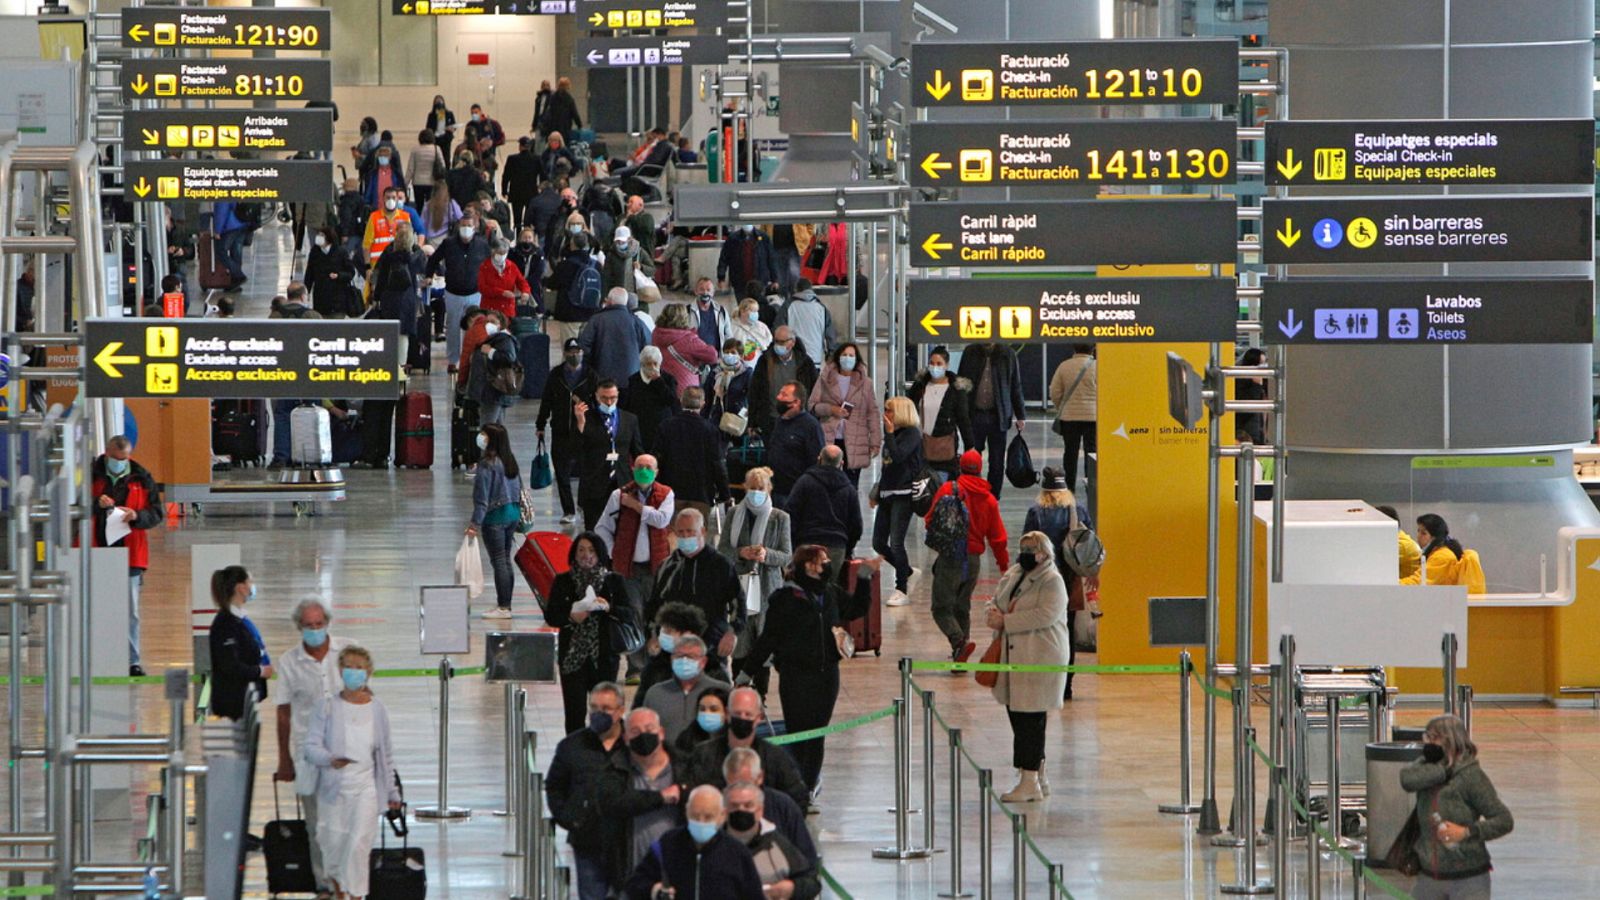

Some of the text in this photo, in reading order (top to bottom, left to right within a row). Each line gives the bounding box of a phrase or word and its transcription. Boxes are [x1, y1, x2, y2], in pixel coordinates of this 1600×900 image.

[181, 14, 227, 24] Facturació
[181, 25, 215, 34] Check-in
[234, 24, 276, 46] 121
[288, 25, 319, 46] 90
[181, 35, 232, 45] Facturación
[1001, 54, 1070, 68] Facturació
[181, 64, 227, 75] Facturació
[181, 76, 215, 85] Check-in
[1001, 71, 1050, 84] Check-in
[1085, 68, 1202, 98] 121 to 10
[181, 85, 232, 95] Facturación
[235, 75, 264, 96] 81
[275, 75, 303, 96] 10
[1001, 85, 1078, 99] Facturación
[1148, 86, 1156, 96] a
[244, 116, 288, 126] Arribades
[244, 128, 274, 136] Arrivals
[244, 137, 286, 148] Llegadas
[1000, 133, 1070, 148] Facturació
[1354, 132, 1498, 148] Equipatges especials
[1000, 151, 1051, 164] Check-in
[1354, 150, 1453, 163] Special Check-in
[1087, 148, 1229, 179] 141 to 130
[184, 167, 278, 178] Equipatges especials
[1000, 166, 1079, 179] Facturación
[1151, 167, 1160, 178] a
[1354, 165, 1496, 180] Equipajes especiales
[184, 178, 212, 188] Special
[184, 188, 278, 200] Equipajes especiales
[960, 214, 1036, 230] Carril ràpid
[1384, 214, 1482, 230] sin barreras
[961, 232, 1014, 244] Fast lane
[1384, 230, 1508, 246] sense barreres
[960, 246, 1045, 262] Carril rápido
[1040, 290, 1140, 305] Accés exclusiu
[1426, 294, 1482, 308] Lavabos
[1040, 308, 1136, 321] Exclusive access
[1426, 312, 1464, 324] Toilets
[1040, 323, 1154, 336] Acceso exclusivo
[1427, 326, 1466, 340] Aseos
[185, 336, 284, 351] Accés exclusiu
[308, 338, 346, 352] Carril
[185, 353, 278, 366] Exclusive access
[308, 354, 360, 366] Fast lane
[186, 368, 296, 381] Acceso exclusivo
[308, 368, 391, 384] Carril rápido
[1160, 426, 1172, 434] sin
